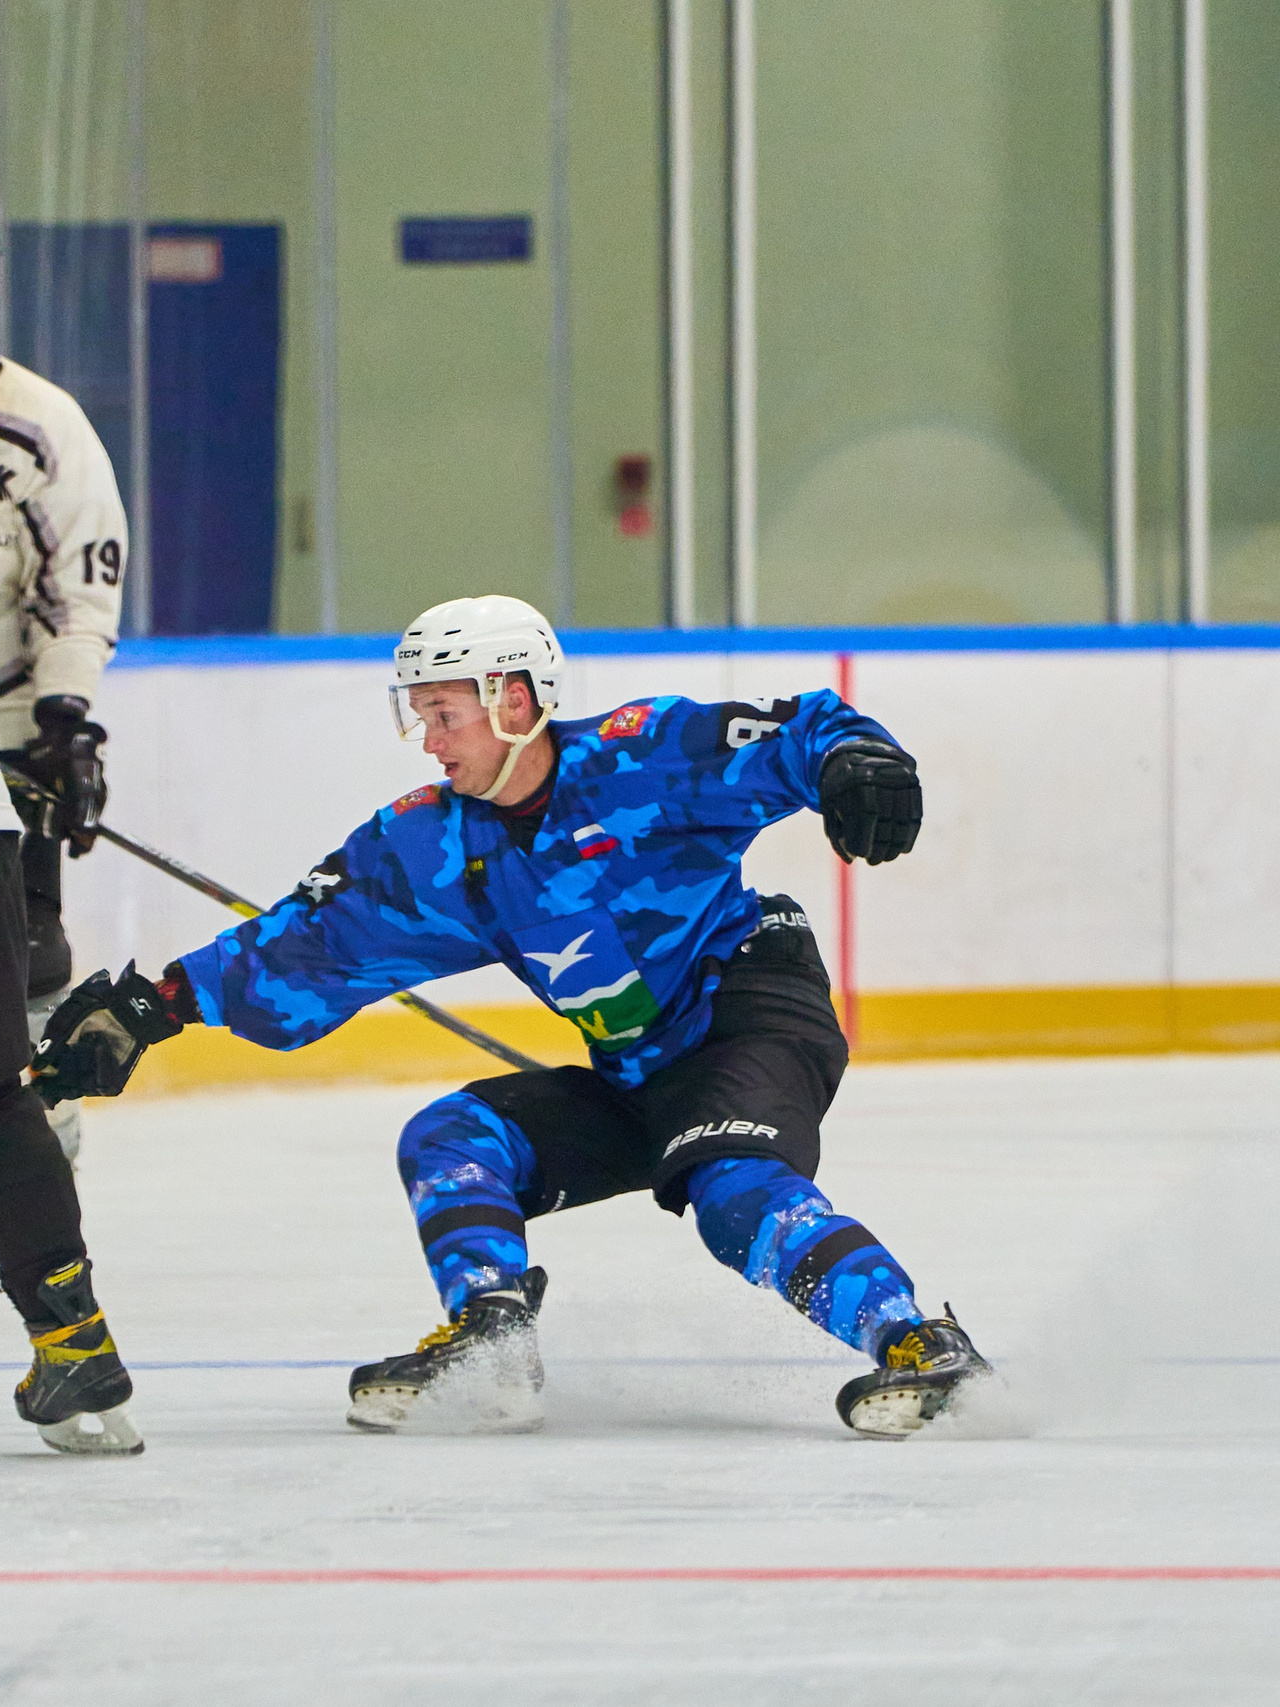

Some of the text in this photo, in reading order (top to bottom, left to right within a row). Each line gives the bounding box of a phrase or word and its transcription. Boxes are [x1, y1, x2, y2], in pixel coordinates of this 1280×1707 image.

[81, 538, 122, 588] 19
[398, 650, 422, 659] CCM
[497, 651, 529, 663] CCM
[756, 911, 810, 931] AUE
[662, 1119, 779, 1159] BAUER
